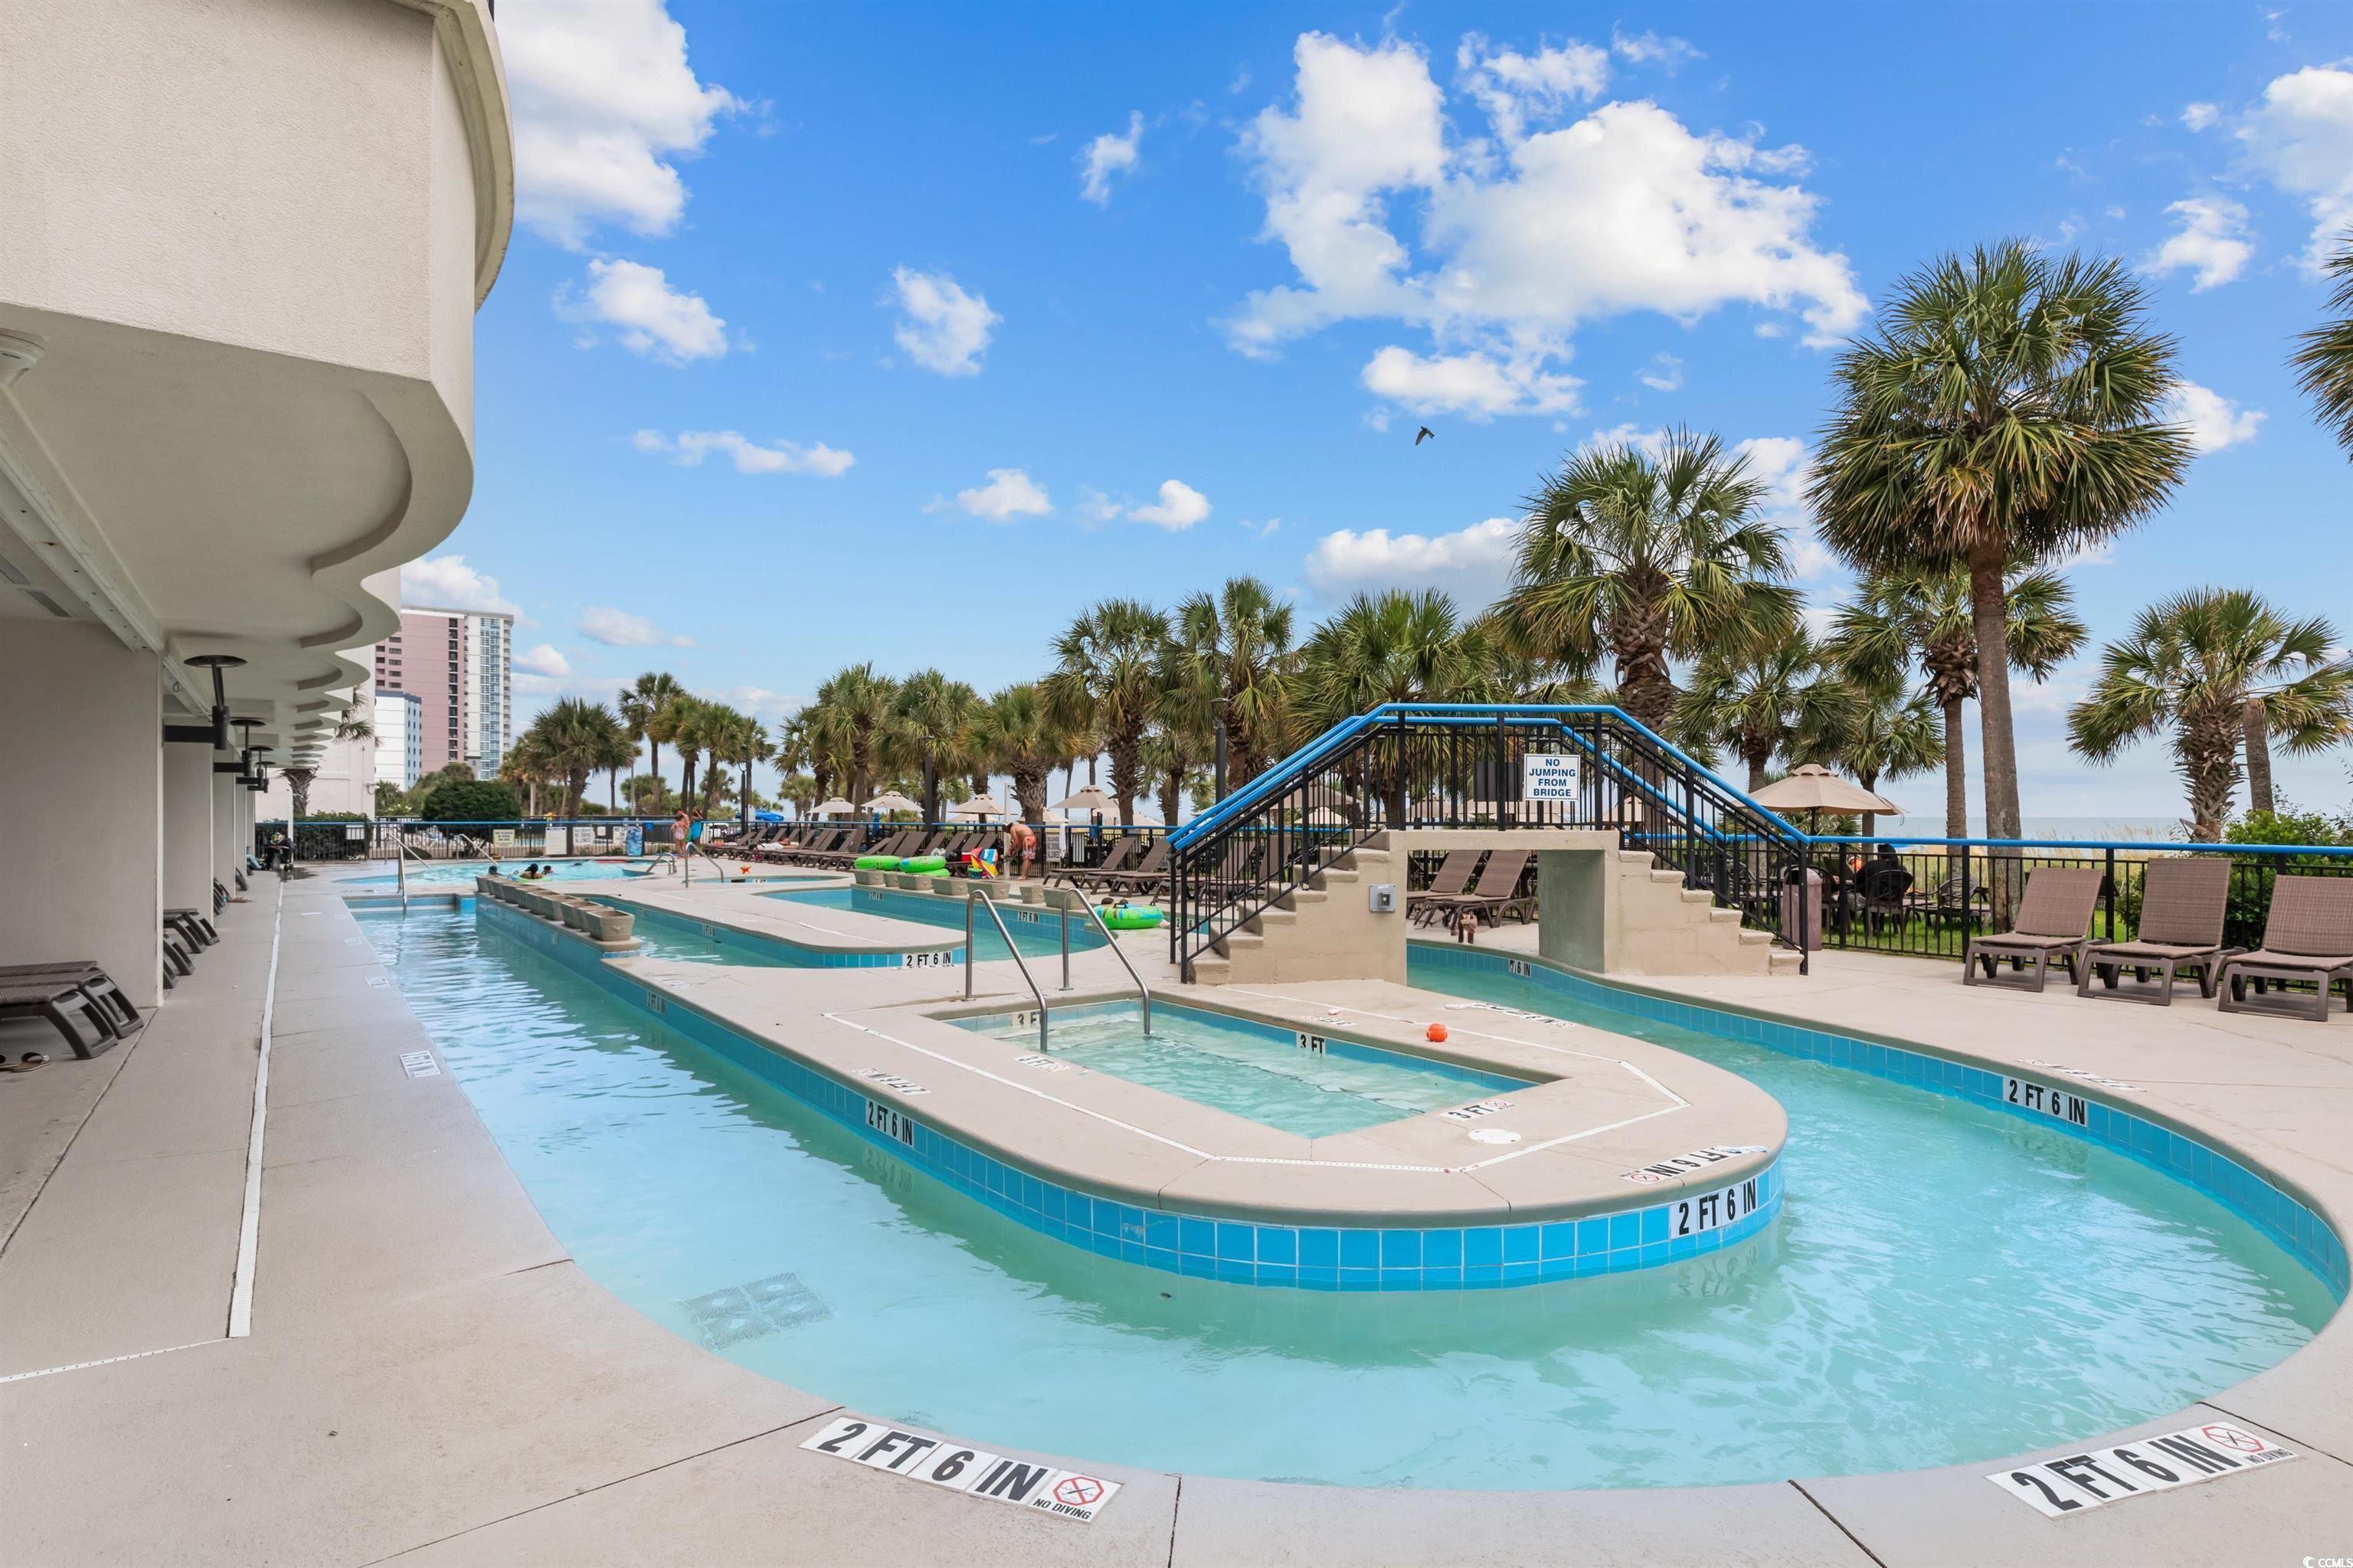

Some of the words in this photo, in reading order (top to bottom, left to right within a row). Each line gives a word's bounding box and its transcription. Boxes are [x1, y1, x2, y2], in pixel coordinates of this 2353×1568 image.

[1529, 768, 1576, 777] JUMPING
[1533, 788, 1571, 797] BRIDGE
[907, 954, 912, 967] 2
[917, 954, 929, 966] FT
[933, 953, 938, 964] 6
[943, 951, 951, 964] IN
[1517, 961, 1521, 974] 6
[1523, 962, 1530, 977] IN
[1300, 1034, 1306, 1048] 3
[1311, 1036, 1324, 1054] FT
[1462, 1105, 1495, 1115] FT
[2009, 1079, 2018, 1103] 2
[2025, 1084, 2044, 1110] FT
[2051, 1092, 2060, 1115] 6
[2069, 1096, 2085, 1125] IN
[869, 1101, 874, 1126] 2
[877, 1105, 889, 1133] FT
[892, 1112, 897, 1137] 6
[902, 1116, 912, 1146] IN
[1679, 1202, 1690, 1236] 2
[1699, 1193, 1720, 1230] FT
[1727, 1188, 1736, 1221] 6
[1743, 1178, 1756, 1215] IN
[817, 1422, 867, 1452] 2
[858, 1430, 938, 1469] FT
[931, 1450, 975, 1481] 6
[975, 1459, 1048, 1501] IN
[2112, 1449, 2180, 1482] 6
[2147, 1434, 2243, 1474] IN
[2011, 1471, 2083, 1511] 2
[2044, 1455, 2139, 1499] FT
[1033, 1498, 1052, 1508] NO
[1052, 1503, 1092, 1520] DIVING
